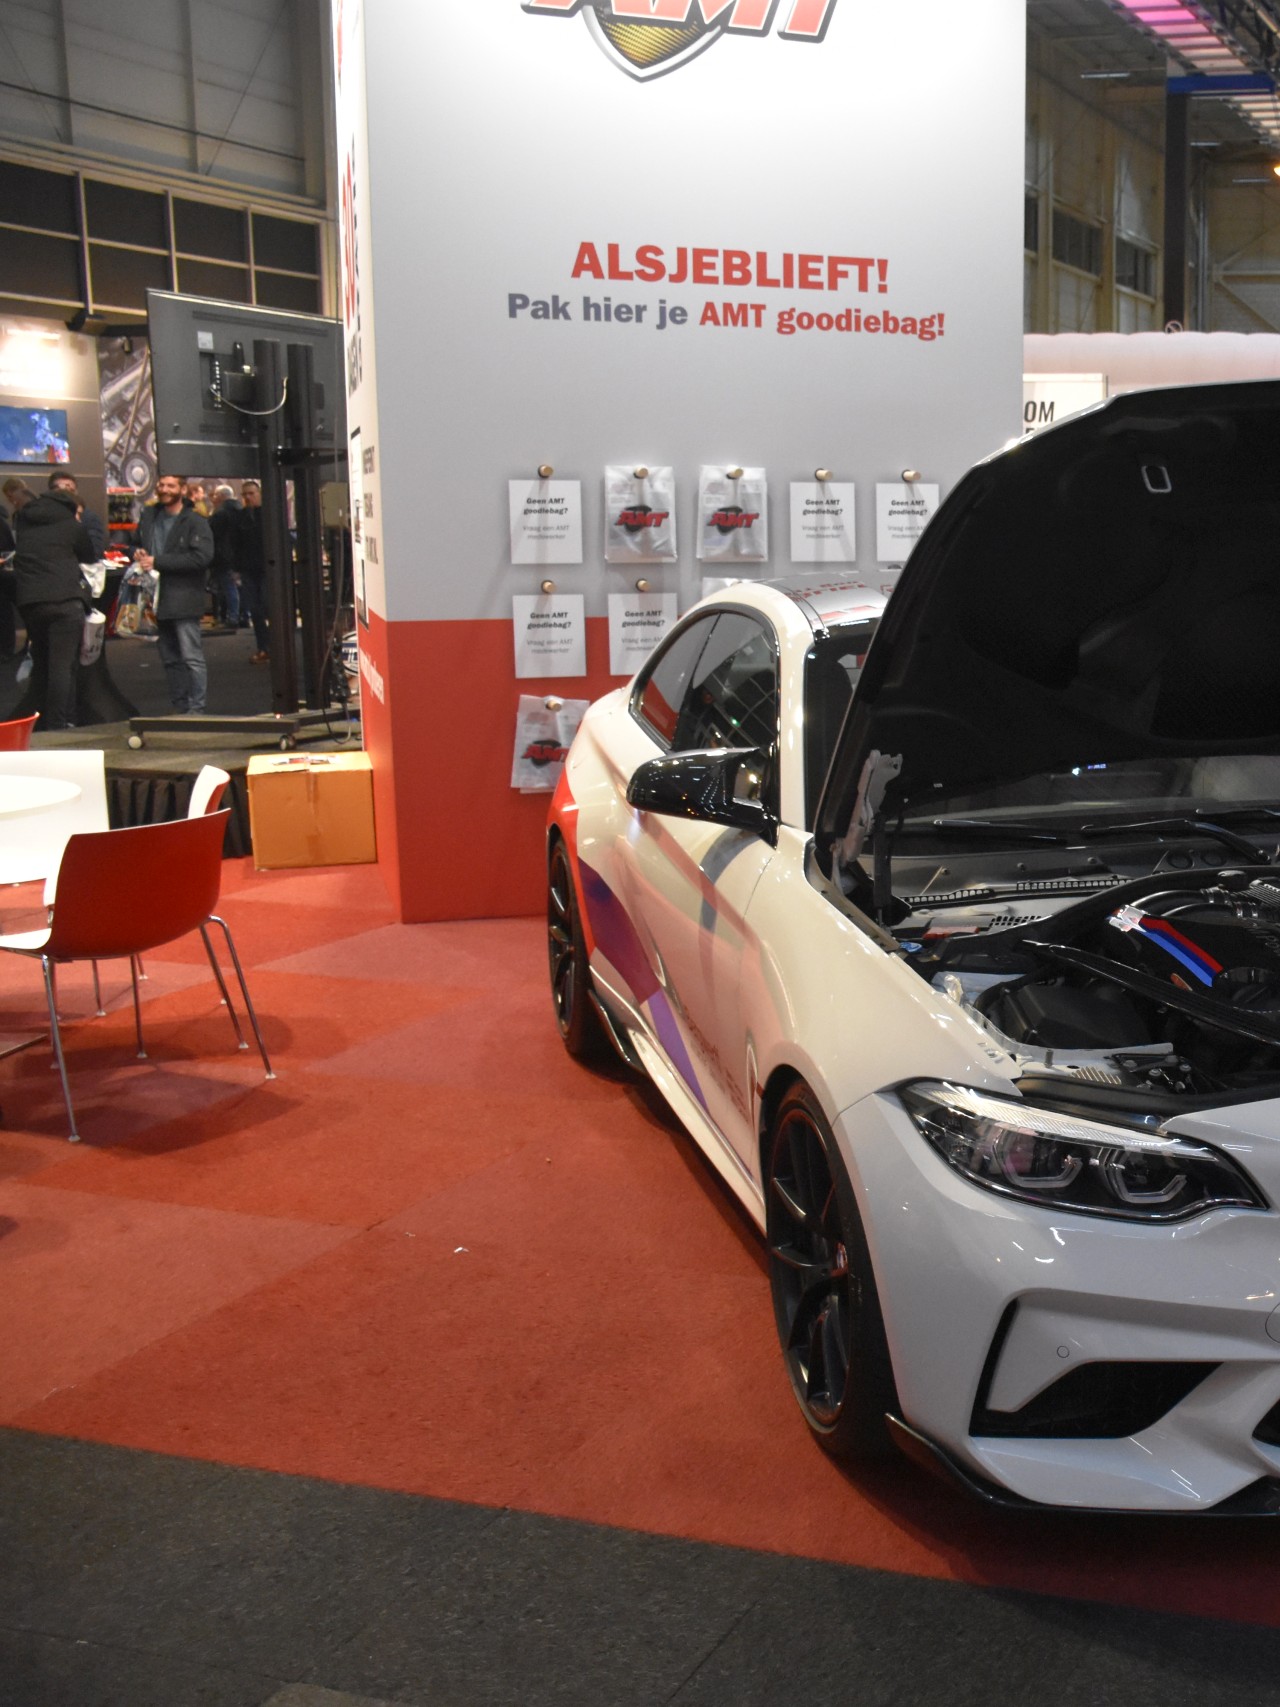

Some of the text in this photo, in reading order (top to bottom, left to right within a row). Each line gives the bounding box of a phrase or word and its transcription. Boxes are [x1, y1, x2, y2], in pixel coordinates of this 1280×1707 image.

[570, 241, 889, 294] ALSJEBLIEFT!
[507, 292, 947, 342] Pak hier je AMT goodiebag!
[523, 507, 568, 515] goodiebag?
[802, 508, 843, 516] goodiebag?
[614, 511, 669, 528] AMT
[706, 512, 760, 529] AMT
[527, 621, 572, 630] goodiebag?
[621, 620, 665, 628] goodiebag?
